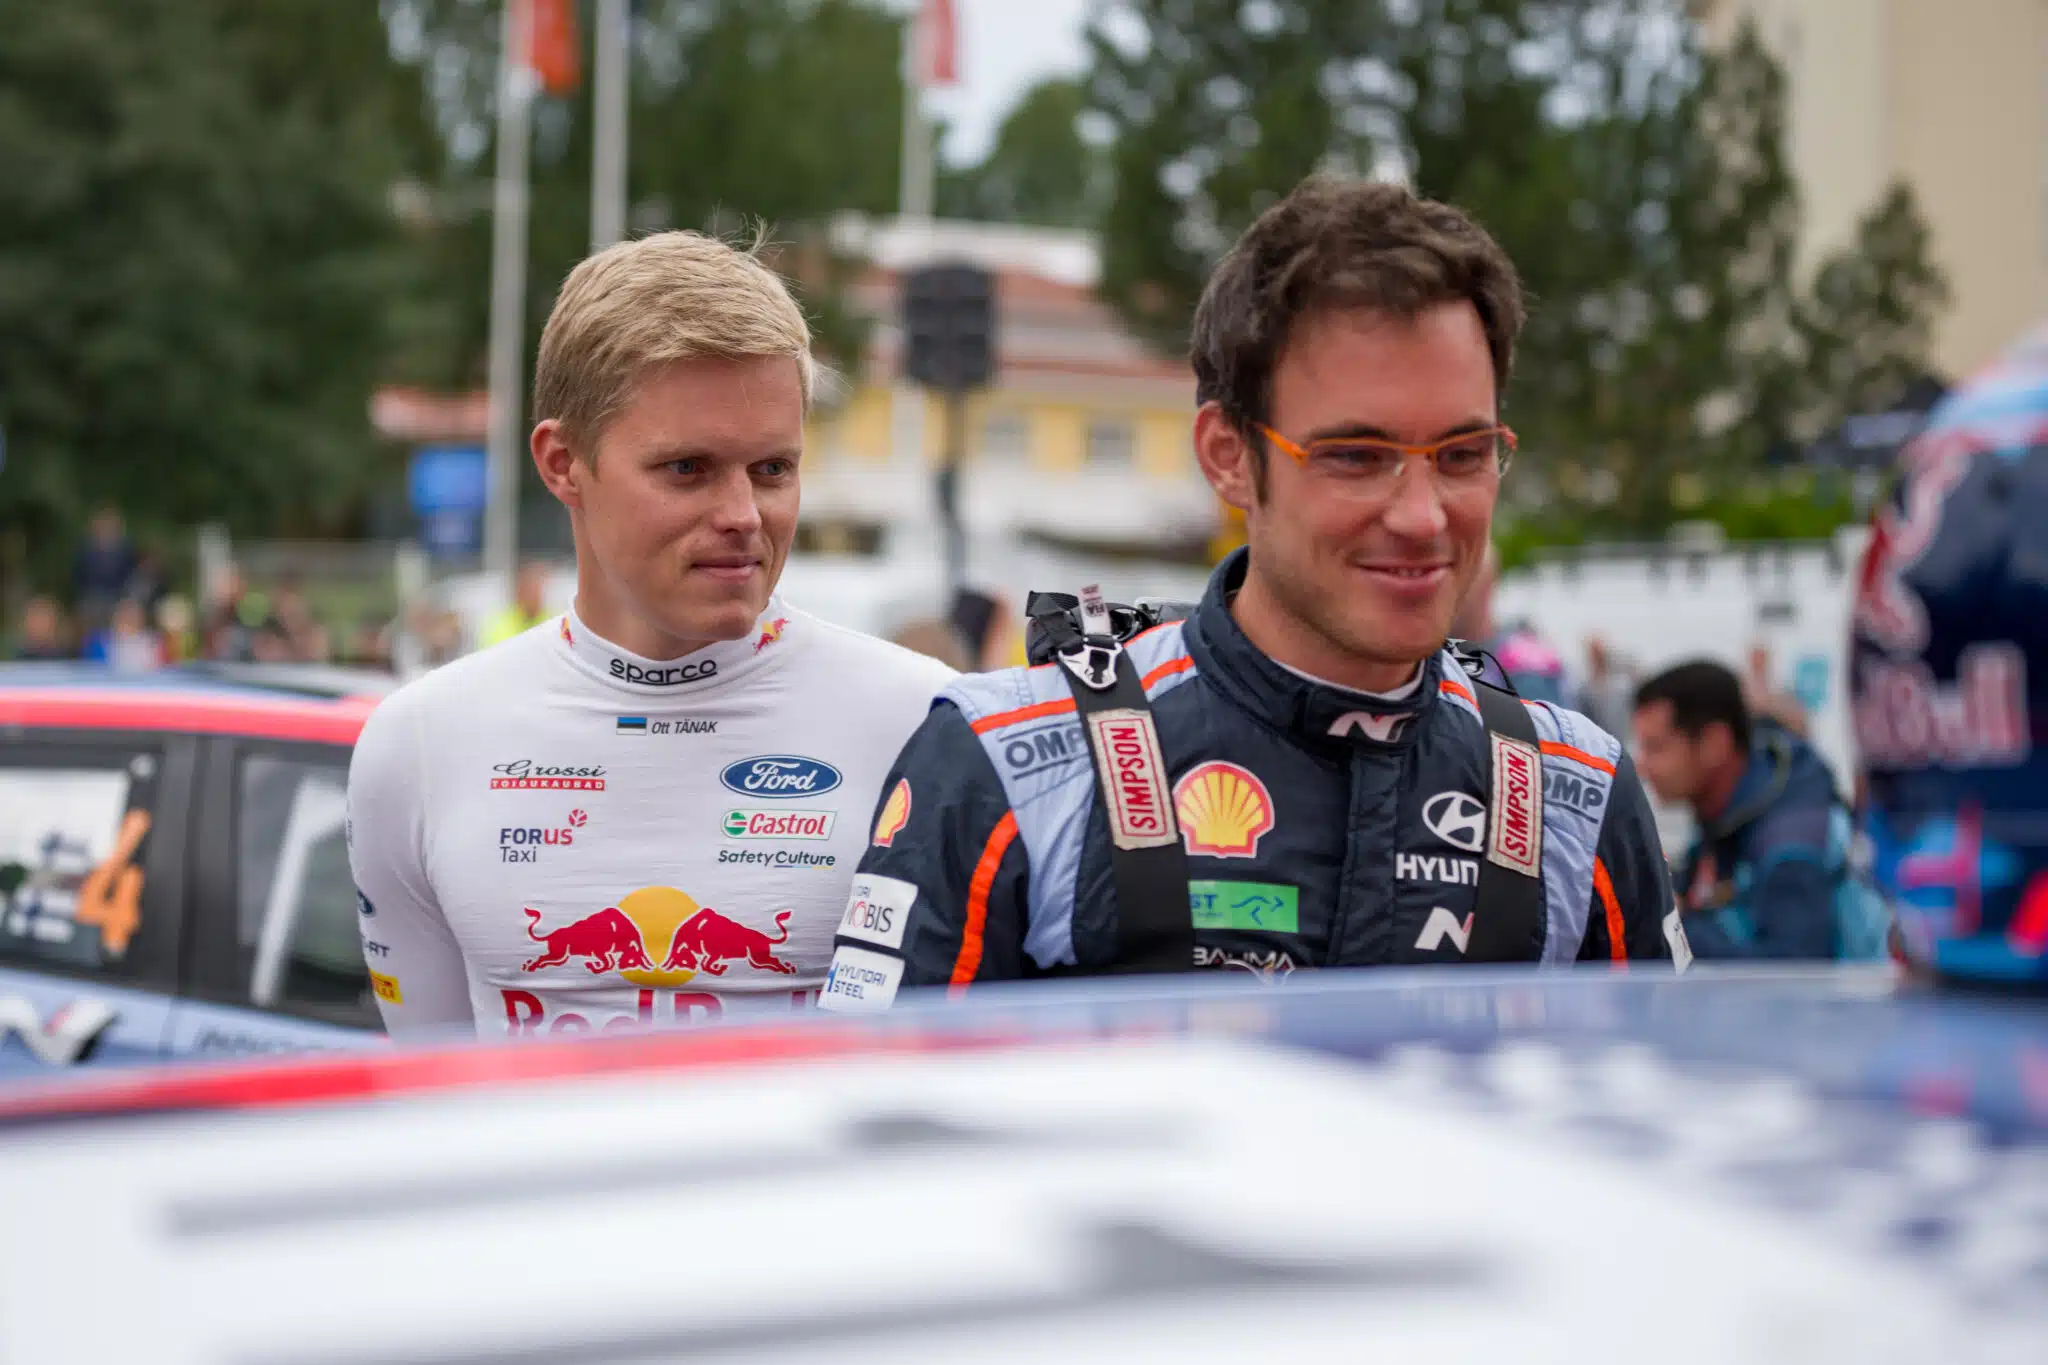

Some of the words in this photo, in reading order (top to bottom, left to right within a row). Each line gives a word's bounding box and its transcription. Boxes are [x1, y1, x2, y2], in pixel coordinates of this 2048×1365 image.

[609, 657, 718, 684] sparco
[651, 719, 669, 735] Ott
[674, 719, 718, 734] TÄNAK
[493, 760, 606, 780] Grossi
[744, 760, 817, 790] Ford
[1110, 727, 1157, 830] SIMPSON
[1504, 751, 1528, 858] SIMPSON
[500, 827, 573, 845] FORUS
[749, 813, 826, 837] Castrol
[500, 845, 537, 863] Taxi
[838, 963, 887, 988] HYUNDAI
[833, 980, 864, 999] STEEL
